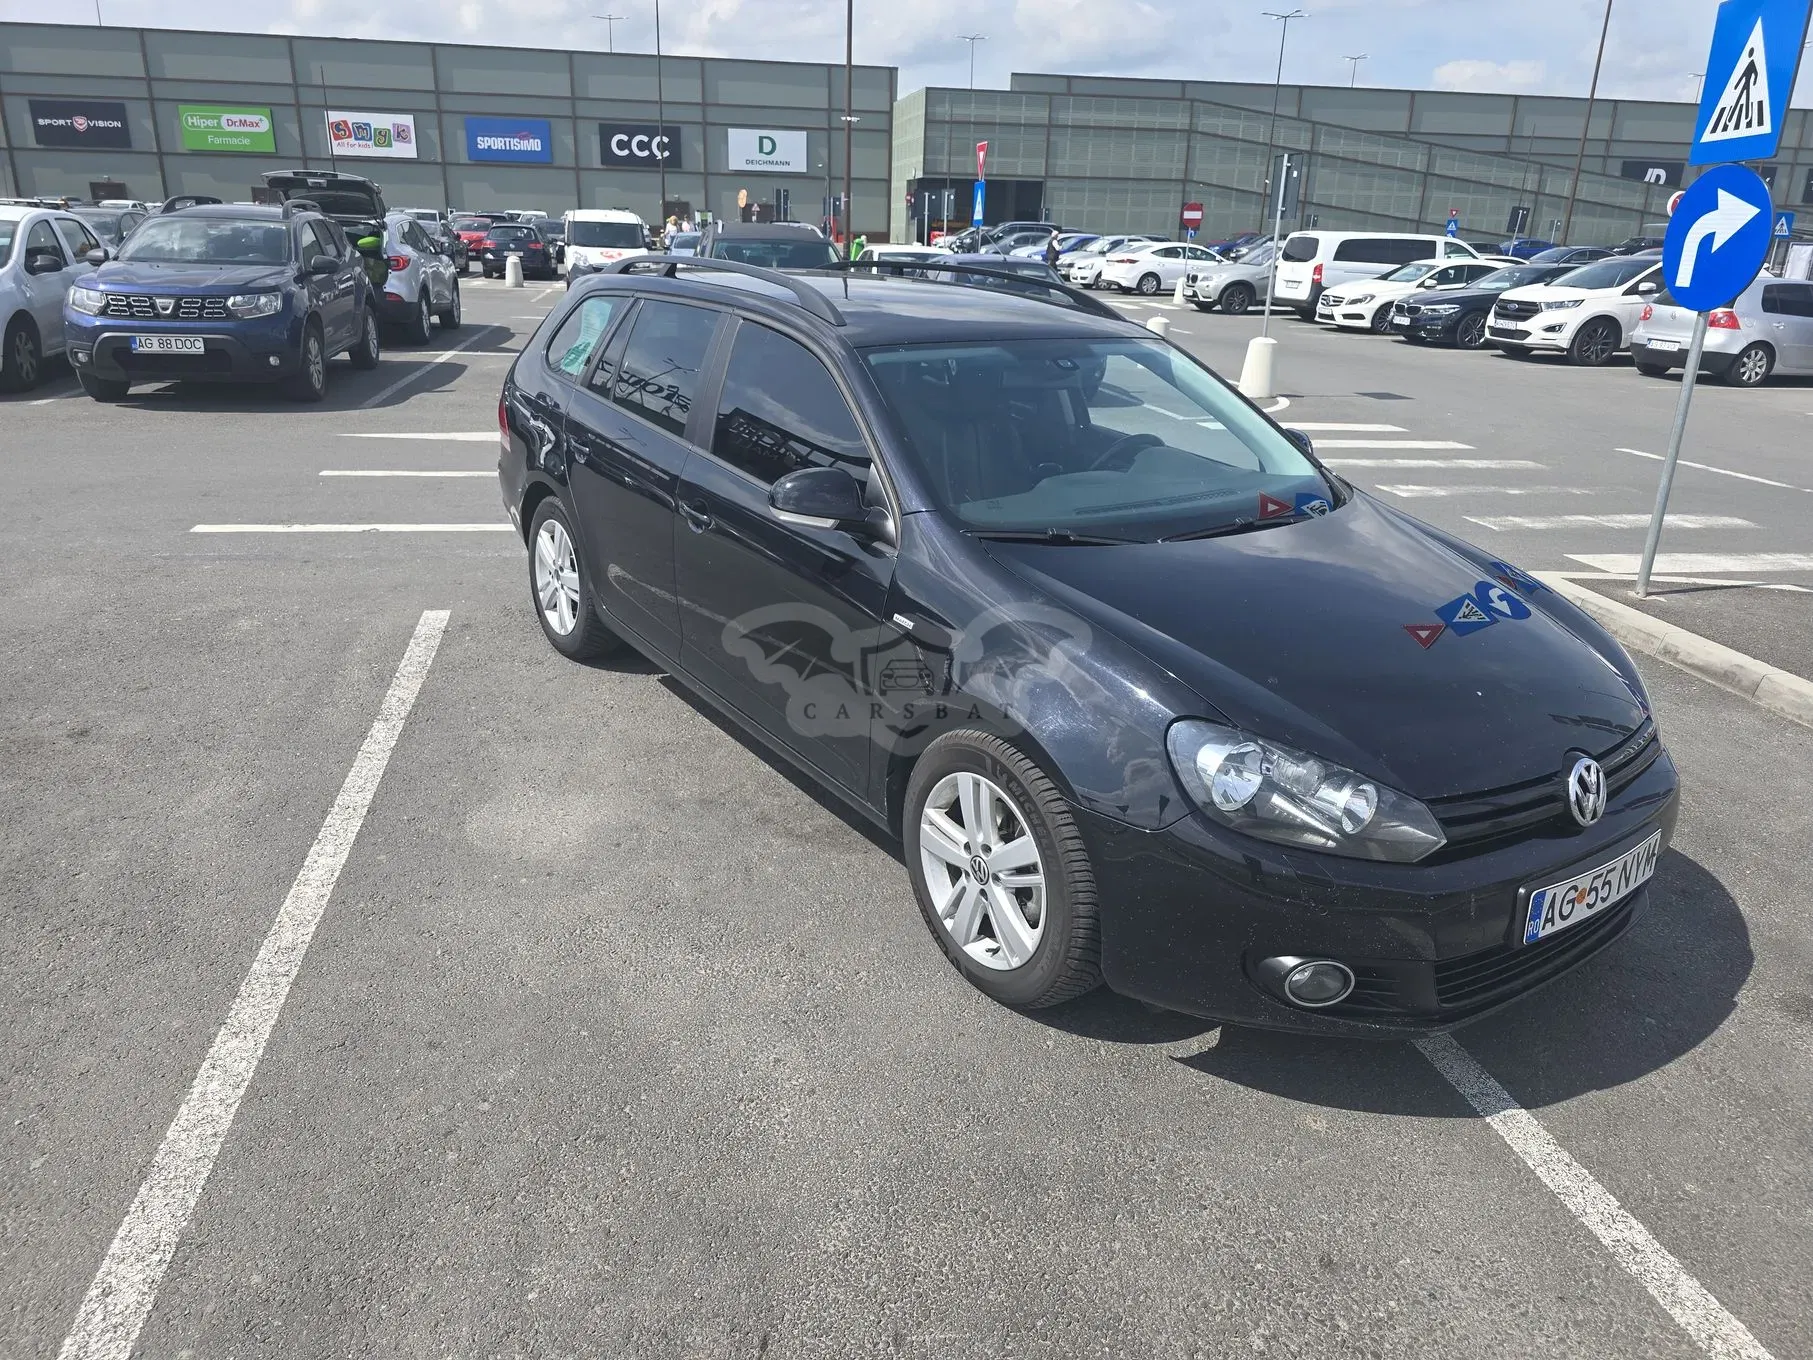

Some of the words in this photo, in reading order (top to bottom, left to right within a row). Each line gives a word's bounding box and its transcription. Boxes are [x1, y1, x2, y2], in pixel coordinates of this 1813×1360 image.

[38, 118, 72, 126] SPORT
[88, 120, 122, 128] VISION
[187, 115, 219, 128] Hiper
[207, 135, 251, 145] Farmacie
[476, 136, 542, 152] SPORTISIMO
[611, 134, 670, 157] CCC
[745, 159, 791, 167] DEICHMANN
[138, 338, 153, 349] AG
[158, 338, 173, 349] 88
[174, 338, 202, 350] DOC
[1541, 885, 1579, 931] AG
[1586, 866, 1616, 909] 55
[1527, 919, 1540, 937] RO
